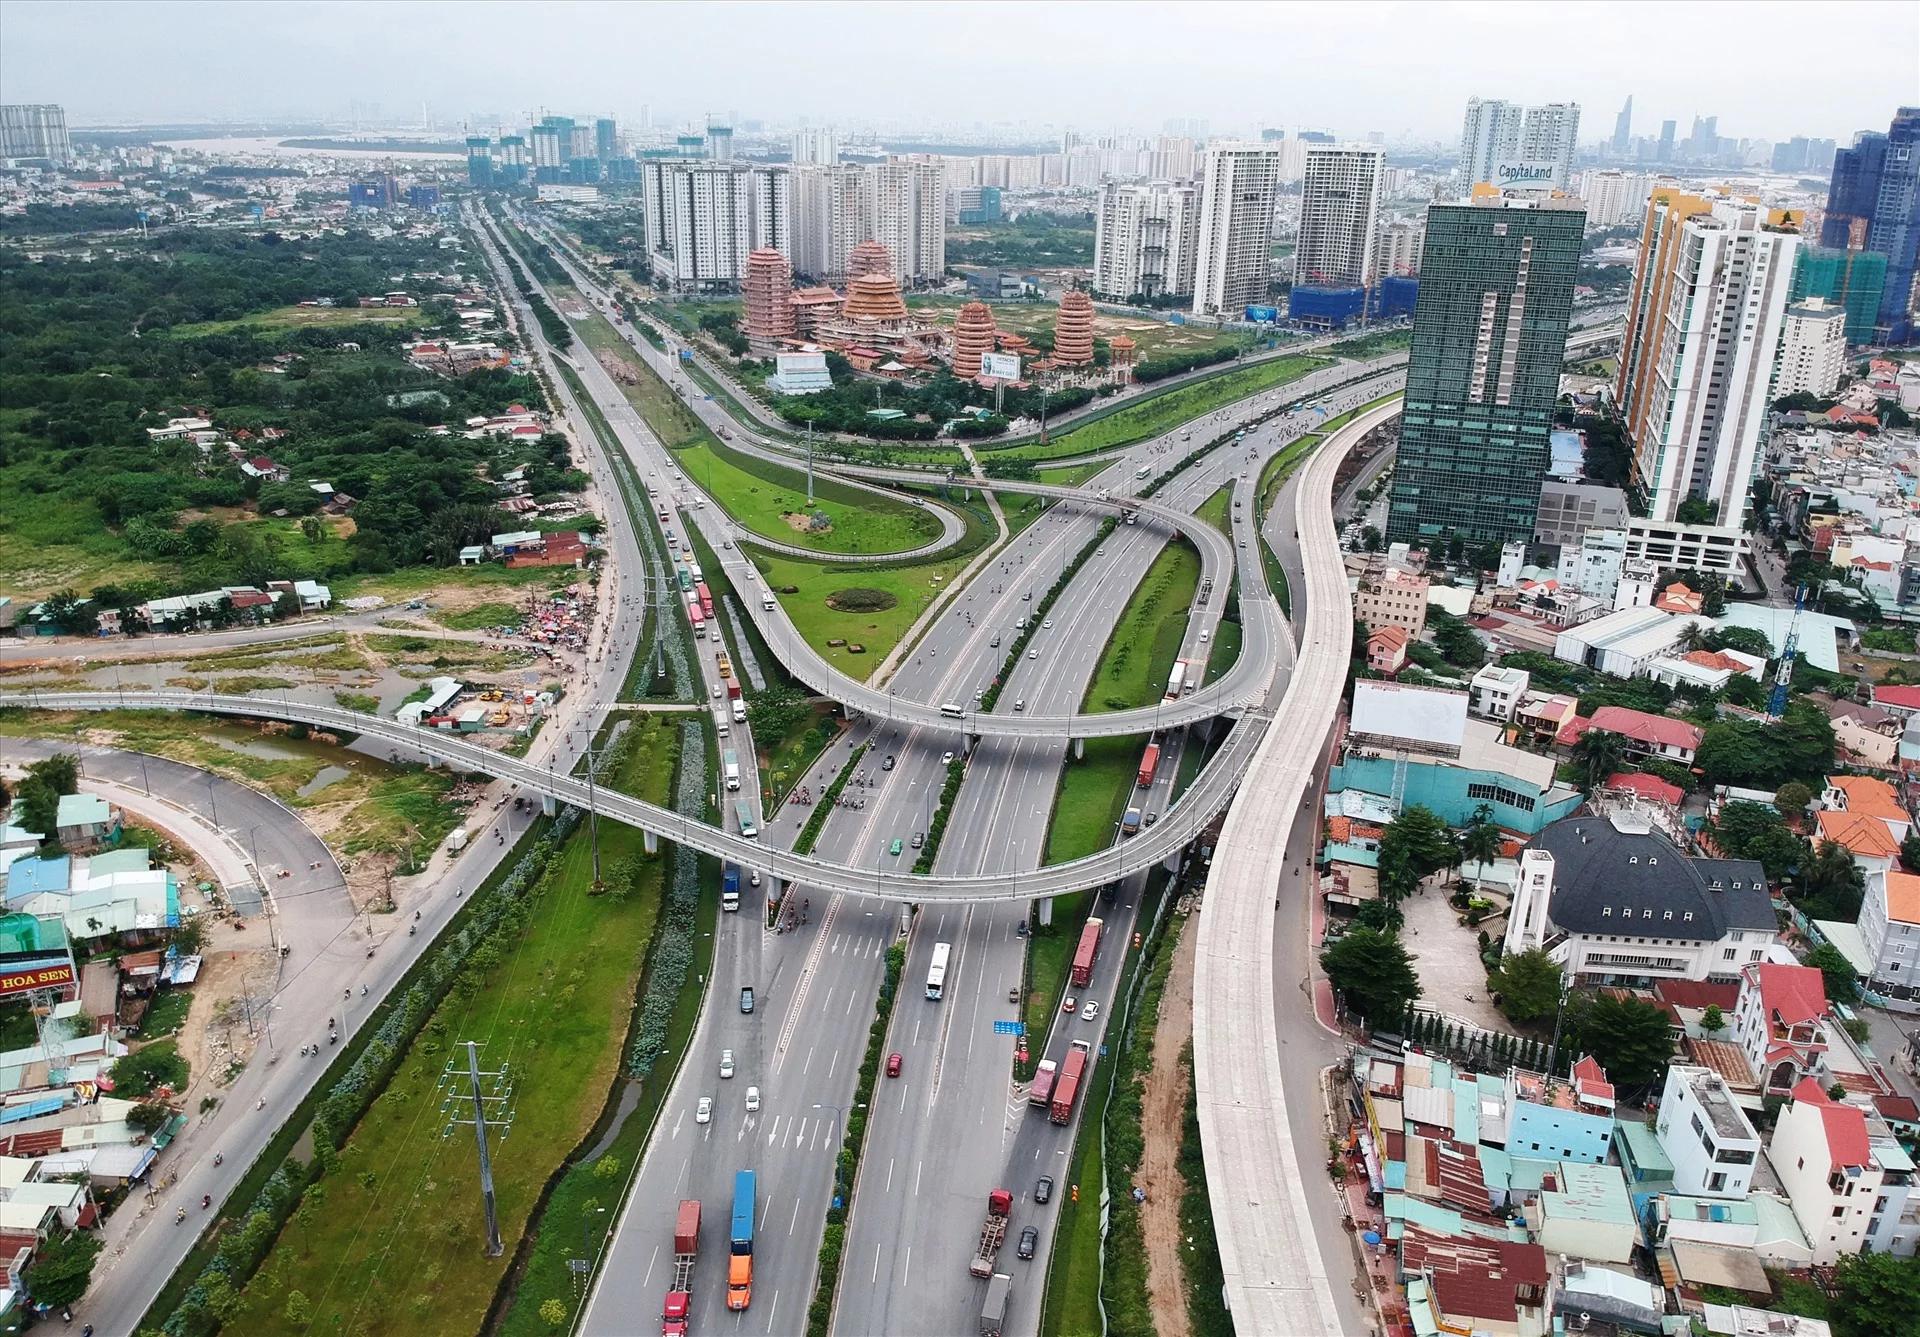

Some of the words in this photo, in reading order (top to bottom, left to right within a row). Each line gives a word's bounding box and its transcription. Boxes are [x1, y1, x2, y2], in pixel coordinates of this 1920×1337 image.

[1498, 163, 1553, 181] CapitaLand
[1, 975, 36, 989] HOA
[38, 968, 70, 982] SEN
